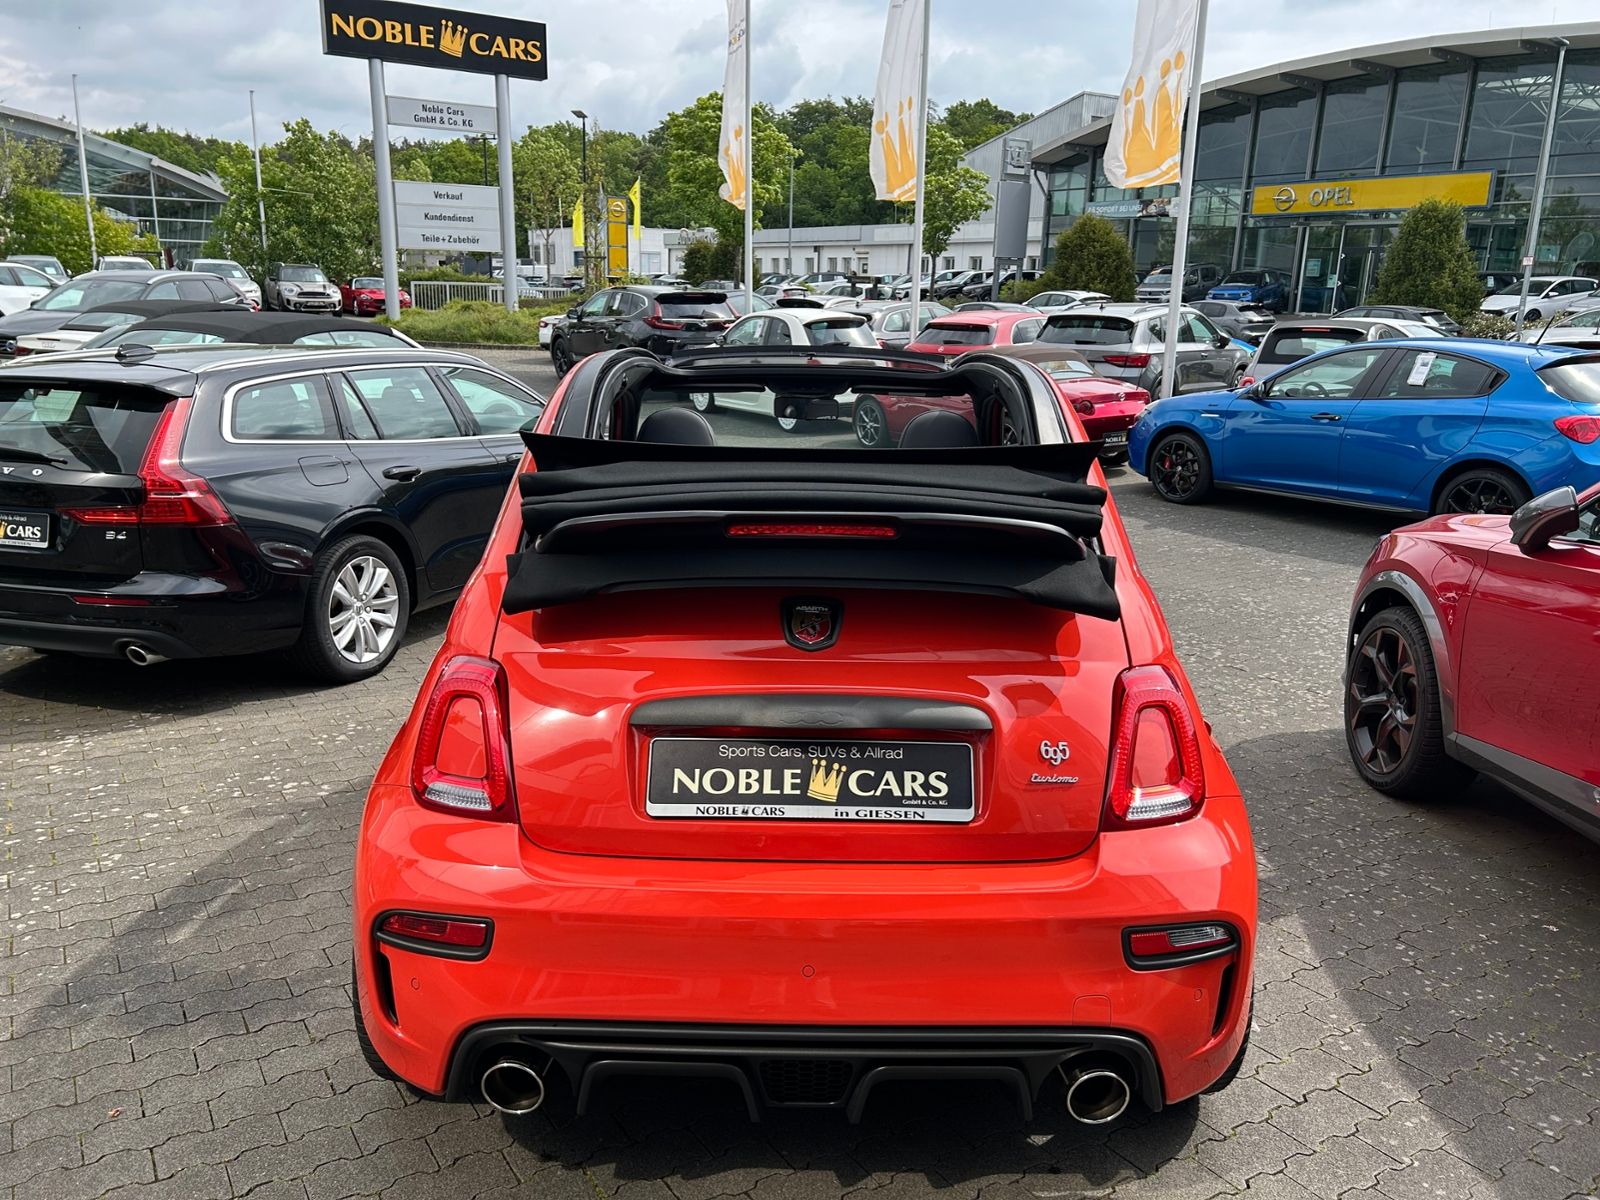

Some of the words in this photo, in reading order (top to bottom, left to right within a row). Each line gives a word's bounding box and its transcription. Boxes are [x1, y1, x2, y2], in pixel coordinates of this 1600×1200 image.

[331, 13, 434, 48] NOBLE
[469, 32, 542, 62] CARS
[421, 103, 444, 114] Noble
[446, 106, 465, 116] Cars
[413, 114, 437, 124] GmbH
[439, 116, 445, 125] &
[448, 117, 461, 127] Co.
[462, 119, 473, 128] KG
[433, 191, 463, 201] Verkauf
[1309, 186, 1353, 206] OPEL
[424, 212, 474, 223] Kundendienst
[421, 233, 480, 244] Teile+Zubehör
[6, 524, 41, 539] CARS
[105, 531, 127, 540] B4
[718, 744, 766, 759] Sports
[768, 745, 806, 759] Cars,
[808, 746, 847, 758] SUVs
[850, 748, 861, 759] &
[863, 747, 903, 759] Allrad
[1040, 740, 1070, 765] 695
[672, 768, 801, 795] NOBLE
[848, 769, 949, 797] CARS
[696, 806, 738, 815] NOBLE
[751, 806, 785, 816] CARS
[834, 808, 850, 817] in
[855, 809, 925, 819] GIESSEN
